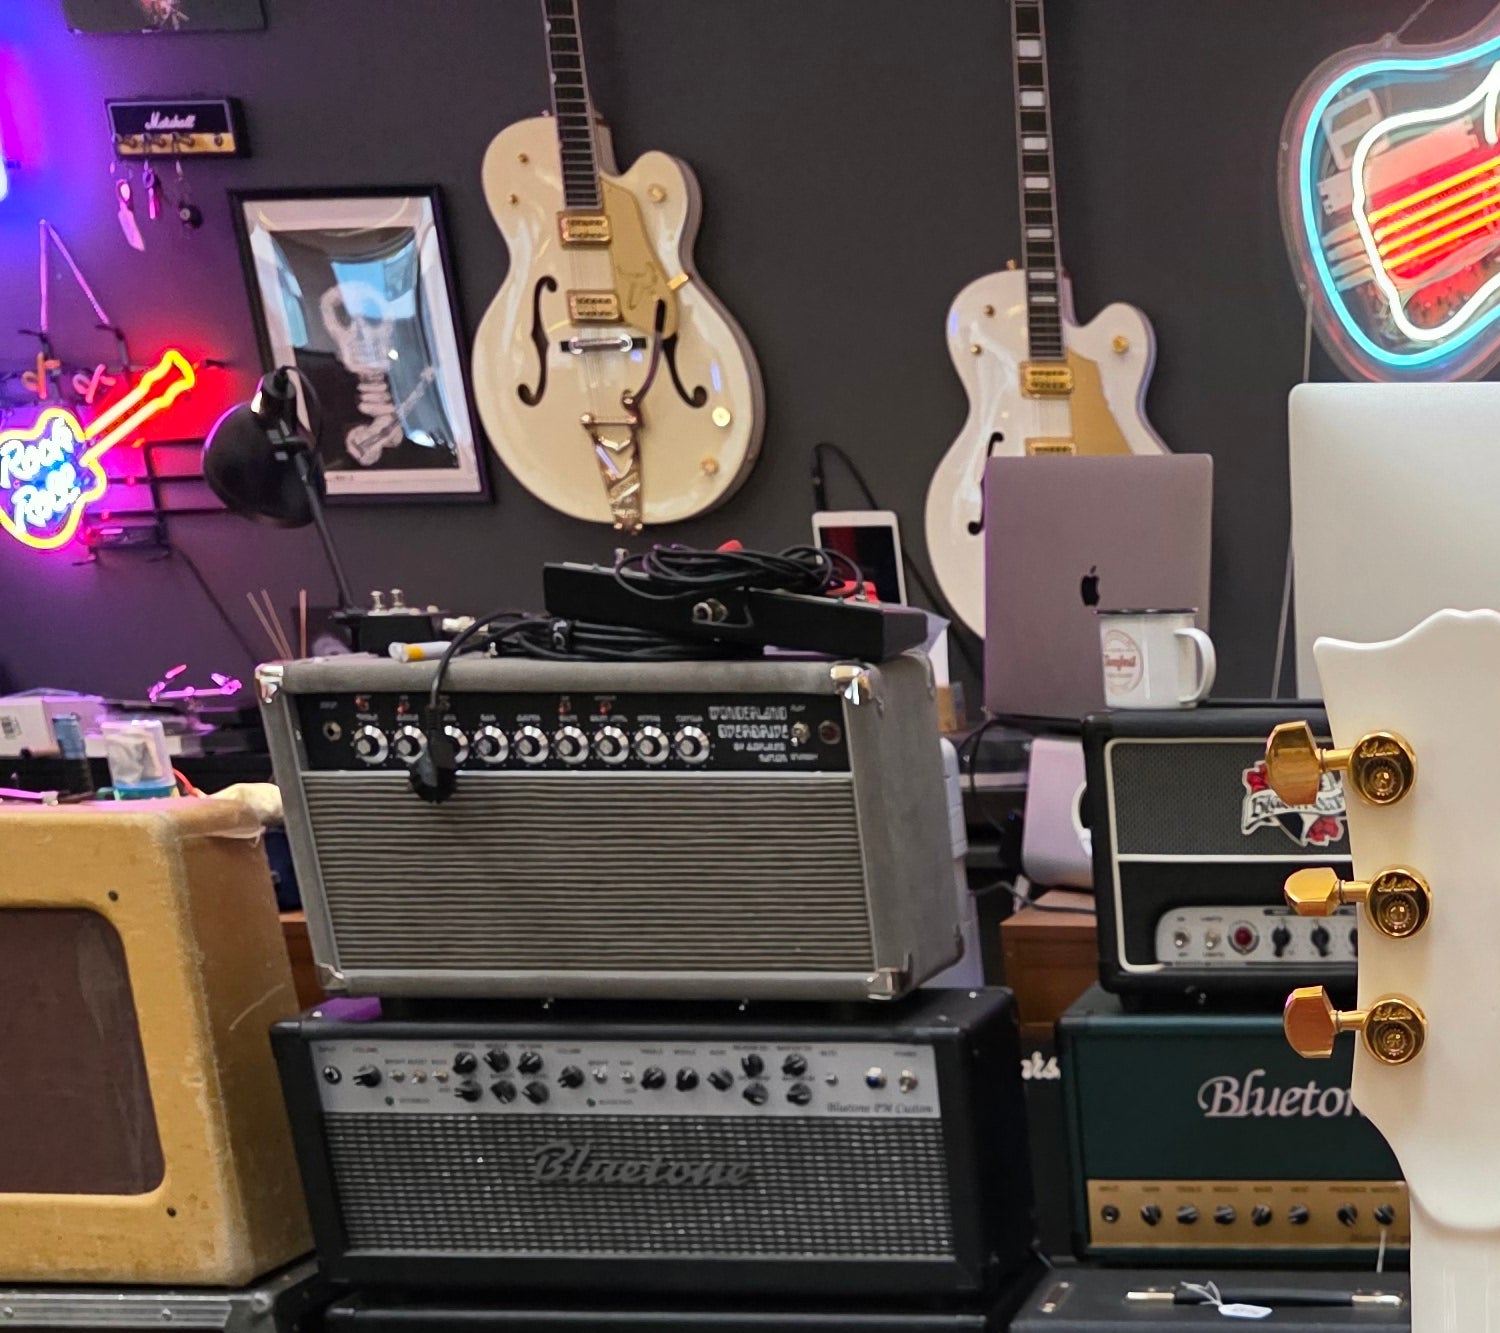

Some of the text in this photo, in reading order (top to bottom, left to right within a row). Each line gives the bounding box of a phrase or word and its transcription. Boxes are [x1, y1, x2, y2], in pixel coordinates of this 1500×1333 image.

[708, 705, 788, 720] WONDERLAND
[717, 724, 789, 739] OVERDRIVE
[1197, 1068, 1362, 1118] Blueto
[534, 1141, 750, 1185] Bluetone
